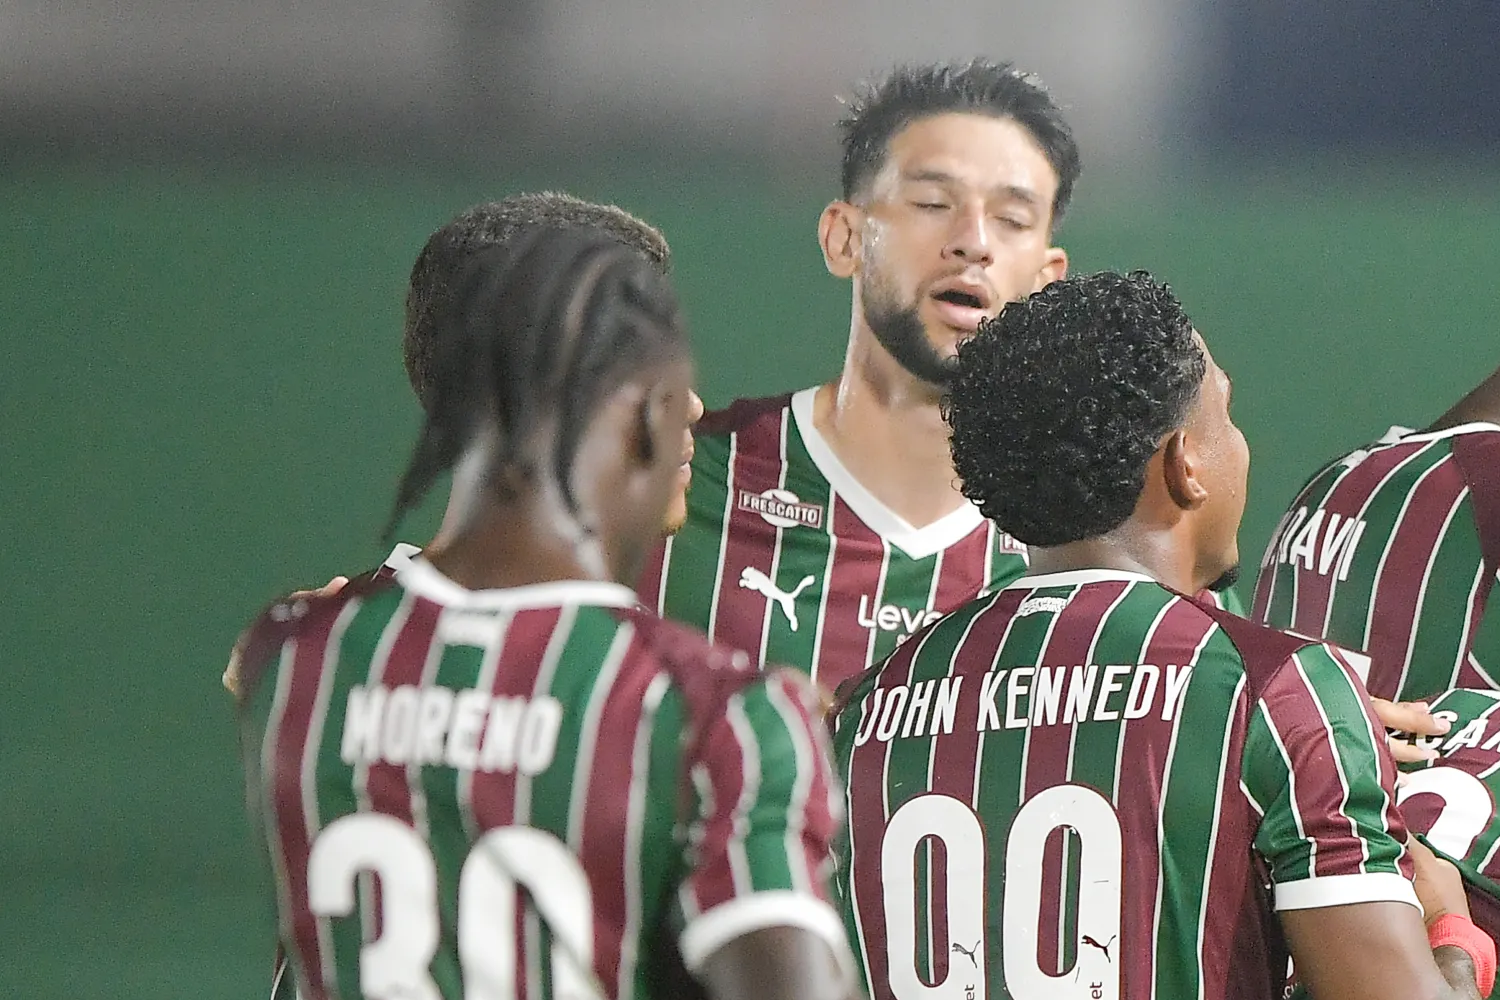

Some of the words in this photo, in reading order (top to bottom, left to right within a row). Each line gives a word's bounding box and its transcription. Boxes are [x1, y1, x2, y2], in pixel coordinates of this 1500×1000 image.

[742, 493, 818, 524] FRESCATTO
[340, 686, 562, 776] MORENO
[854, 676, 963, 747] JOHN
[976, 664, 1194, 732] KENNEDY
